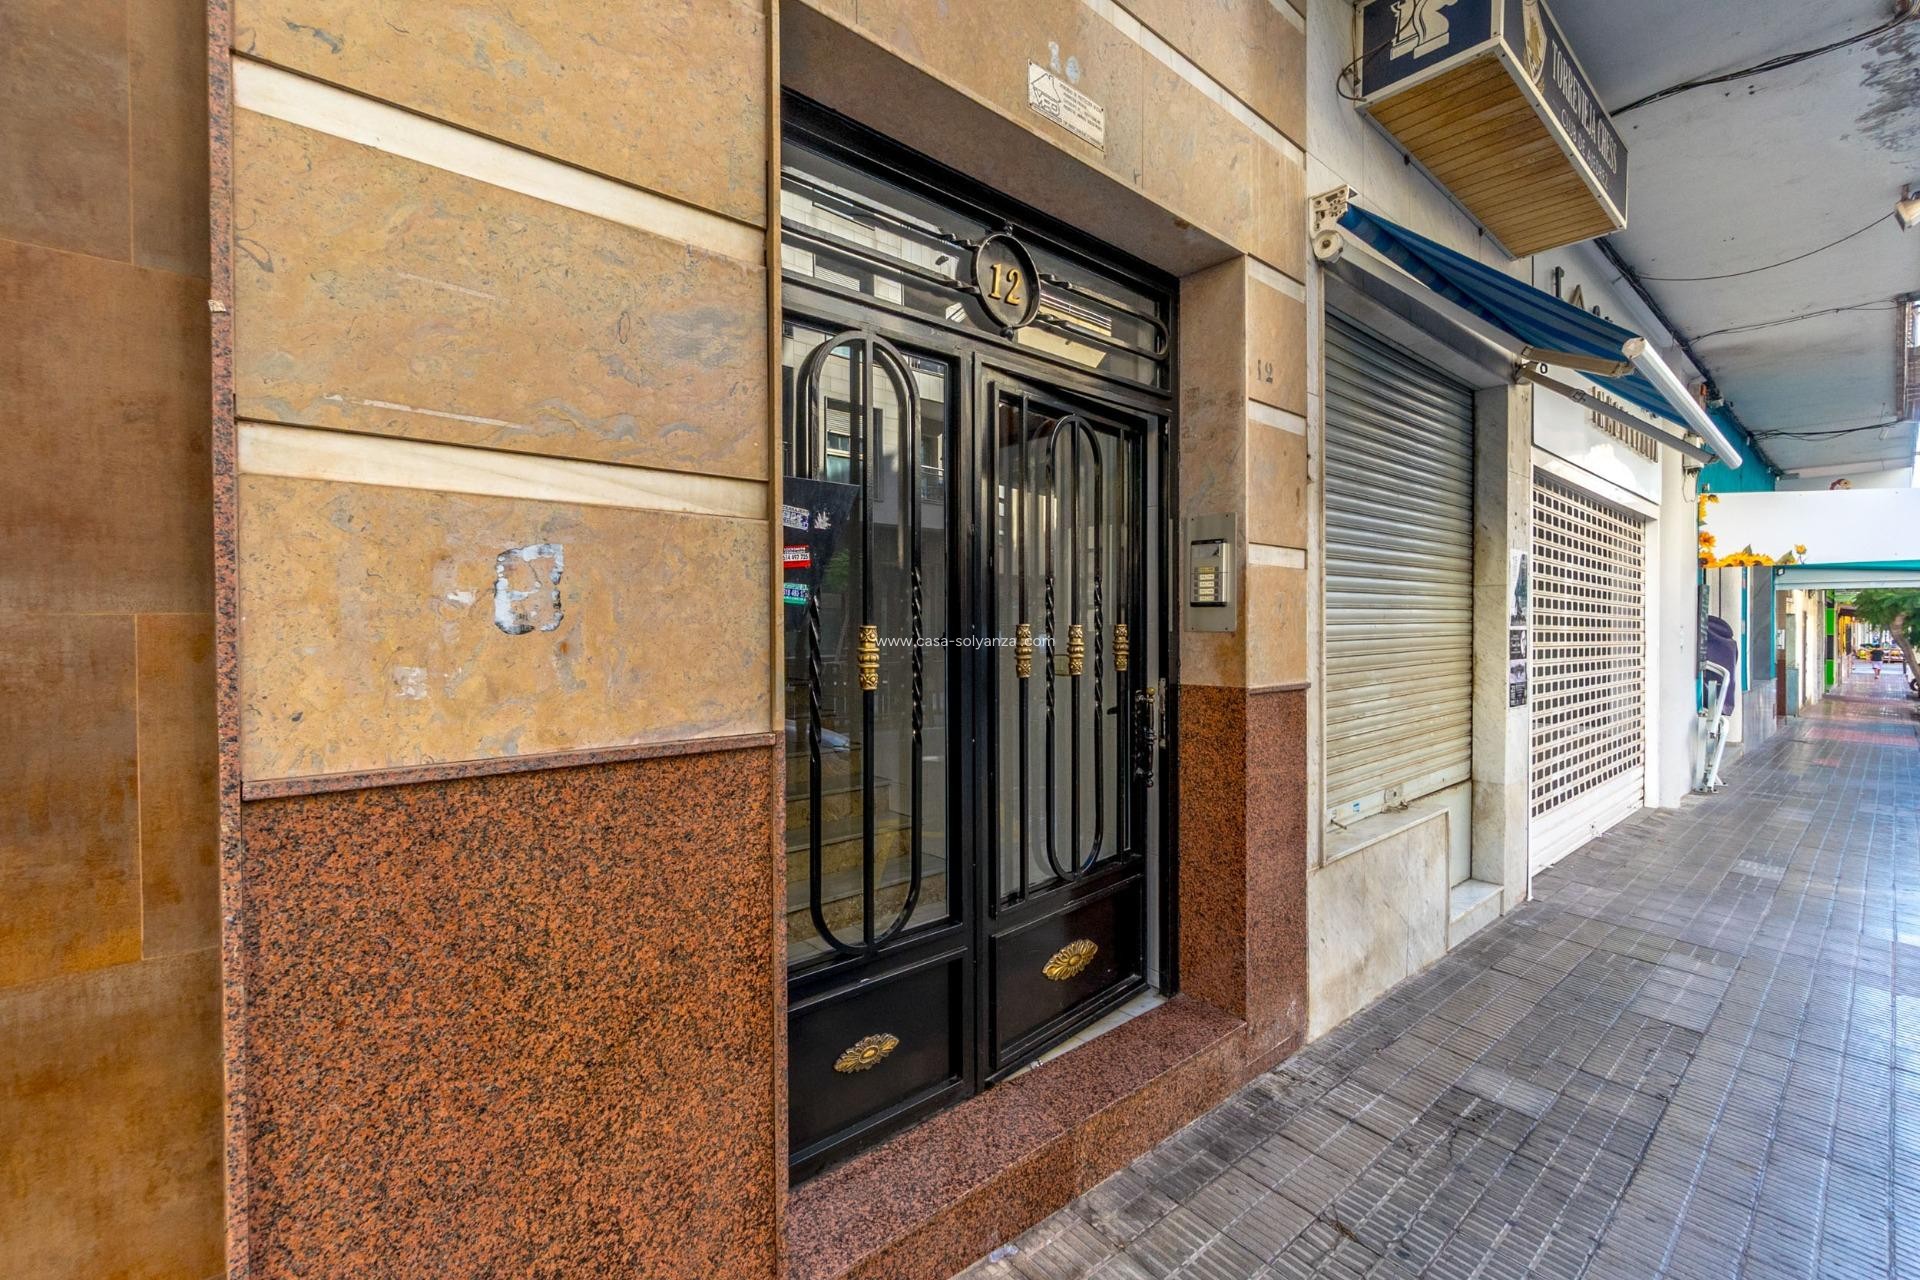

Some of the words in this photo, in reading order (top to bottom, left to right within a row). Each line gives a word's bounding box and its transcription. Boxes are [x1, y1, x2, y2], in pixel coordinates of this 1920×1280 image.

[1552, 39, 1596, 144] TORREVIEJA
[1597, 118, 1617, 174] CHESS
[1561, 109, 1576, 142] CLUB
[988, 263, 1023, 306] 12
